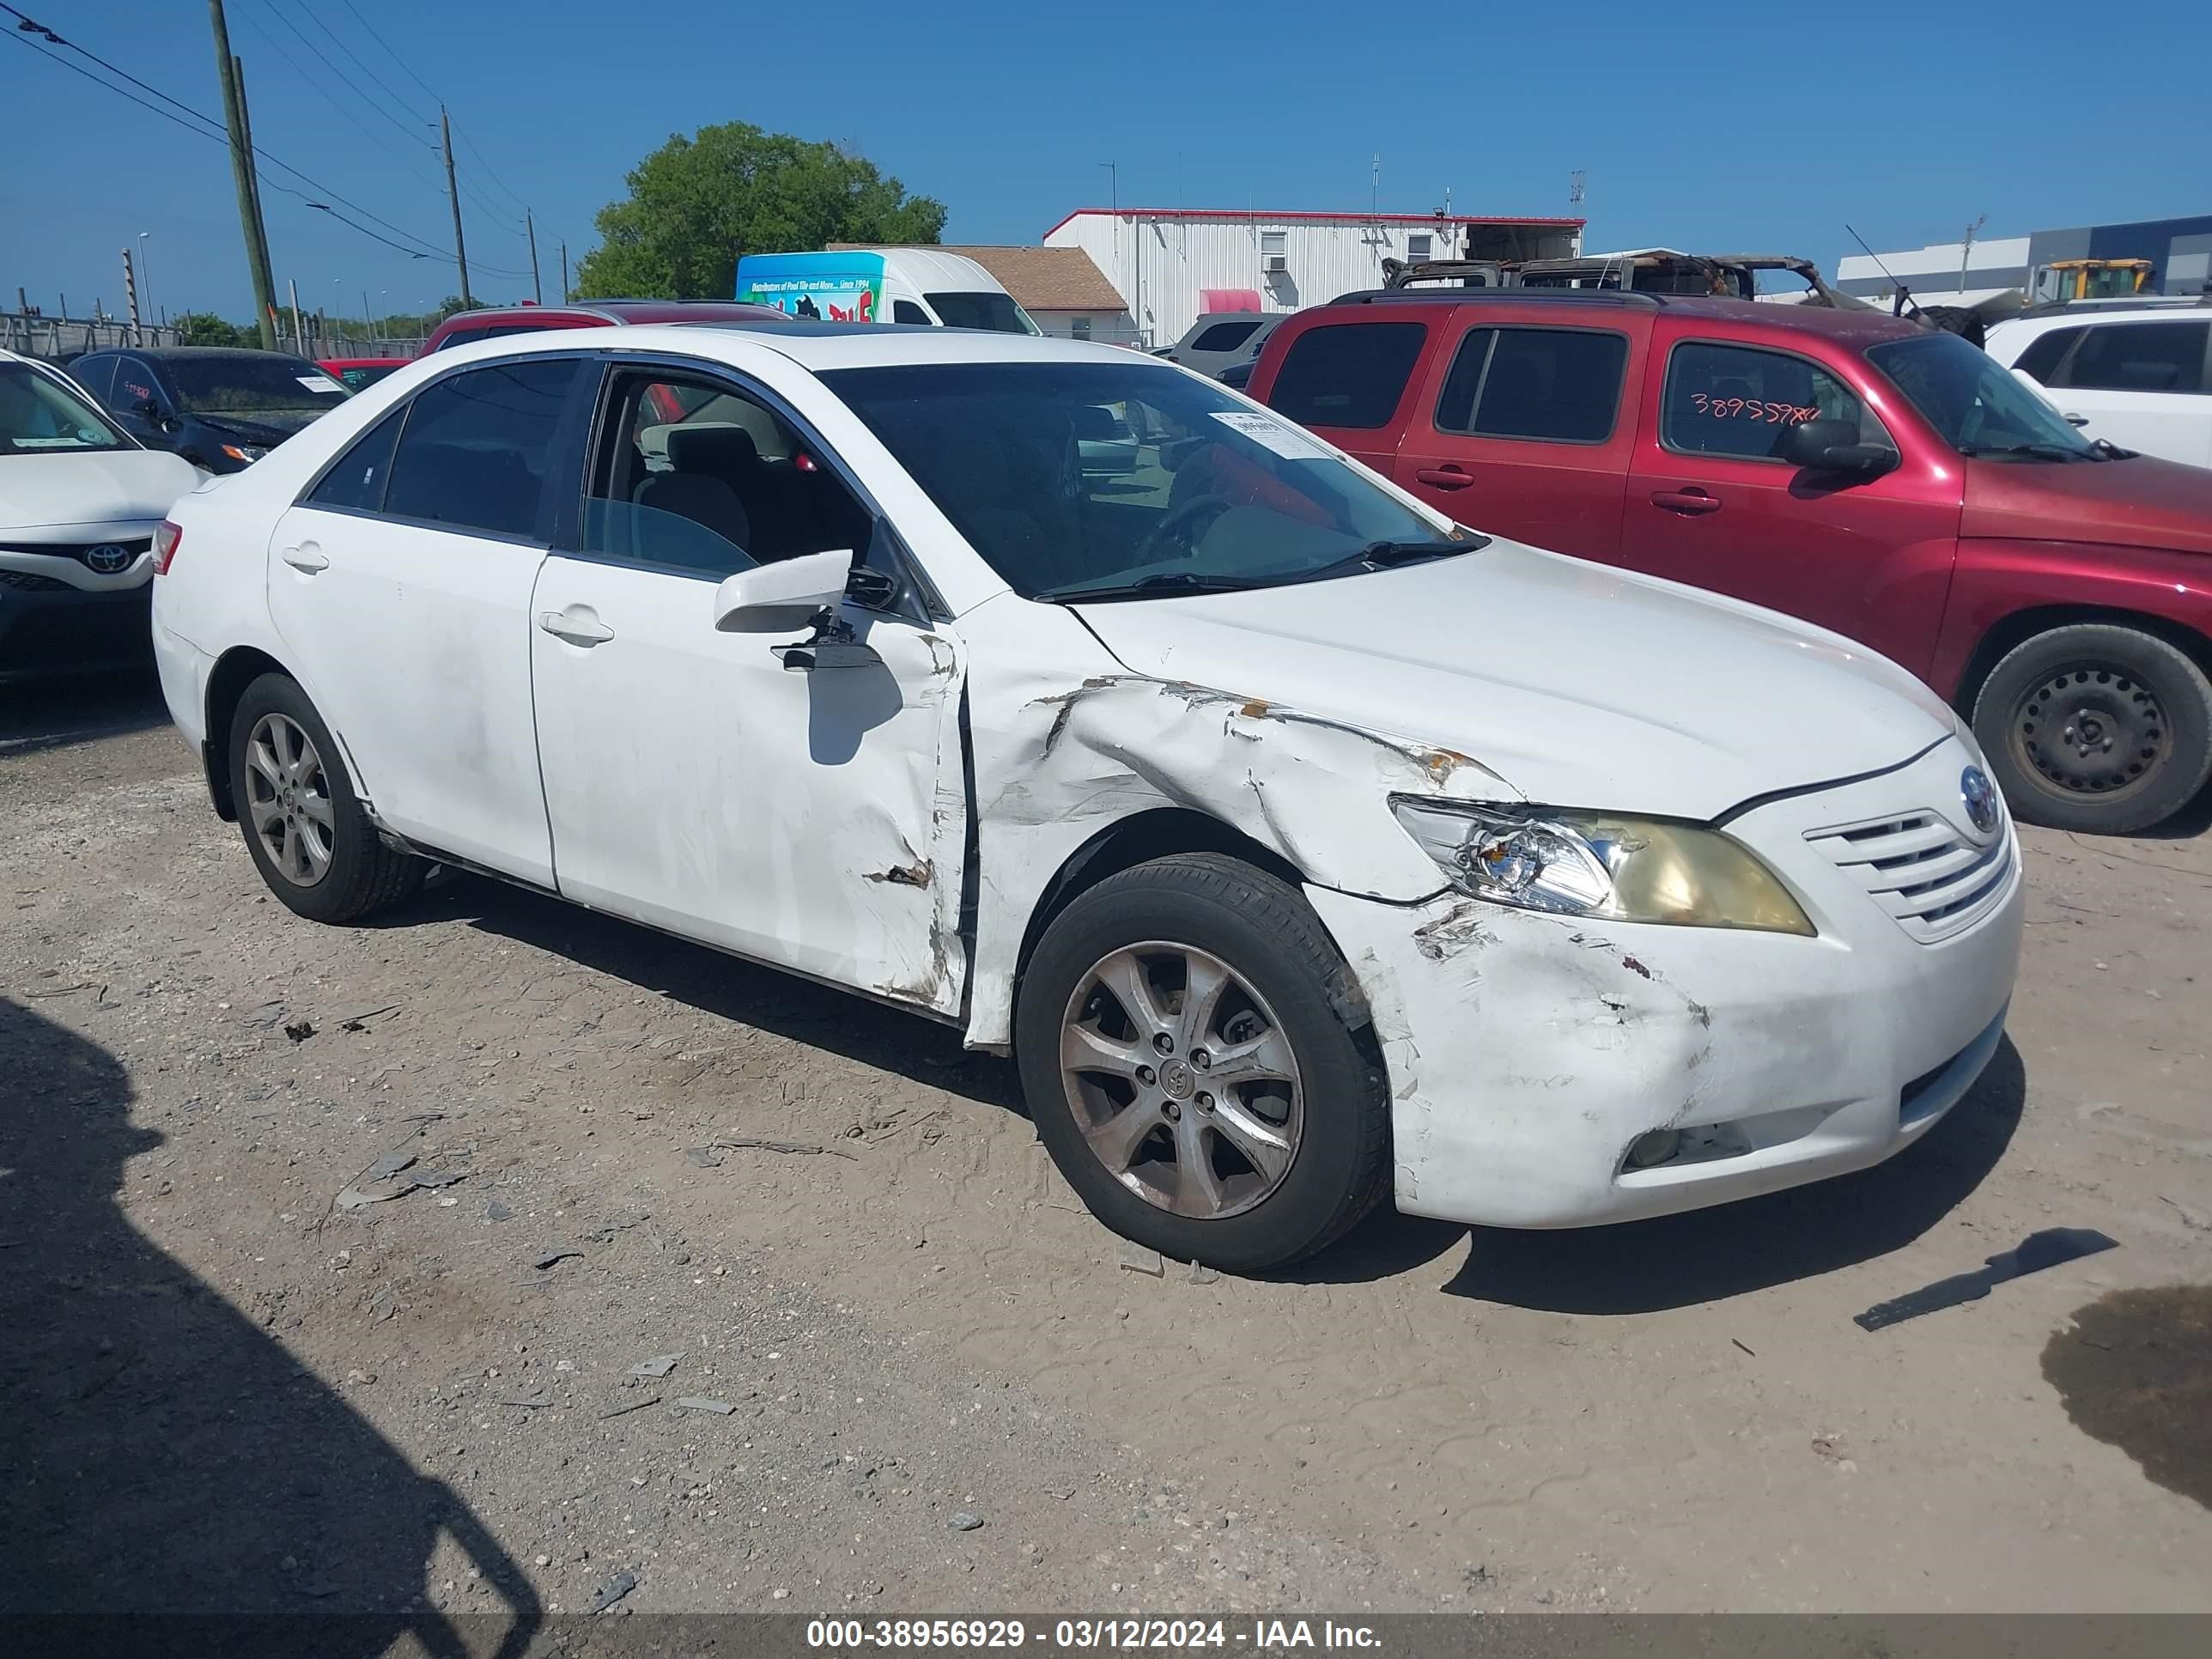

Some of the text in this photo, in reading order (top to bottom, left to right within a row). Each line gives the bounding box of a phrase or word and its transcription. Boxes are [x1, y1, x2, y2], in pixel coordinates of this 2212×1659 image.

[751, 282, 780, 292] Distributors
[781, 282, 787, 291] of
[787, 281, 799, 291] Pool
[809, 280, 819, 290] and
[839, 279, 854, 289] Since
[854, 279, 870, 289] 1994
